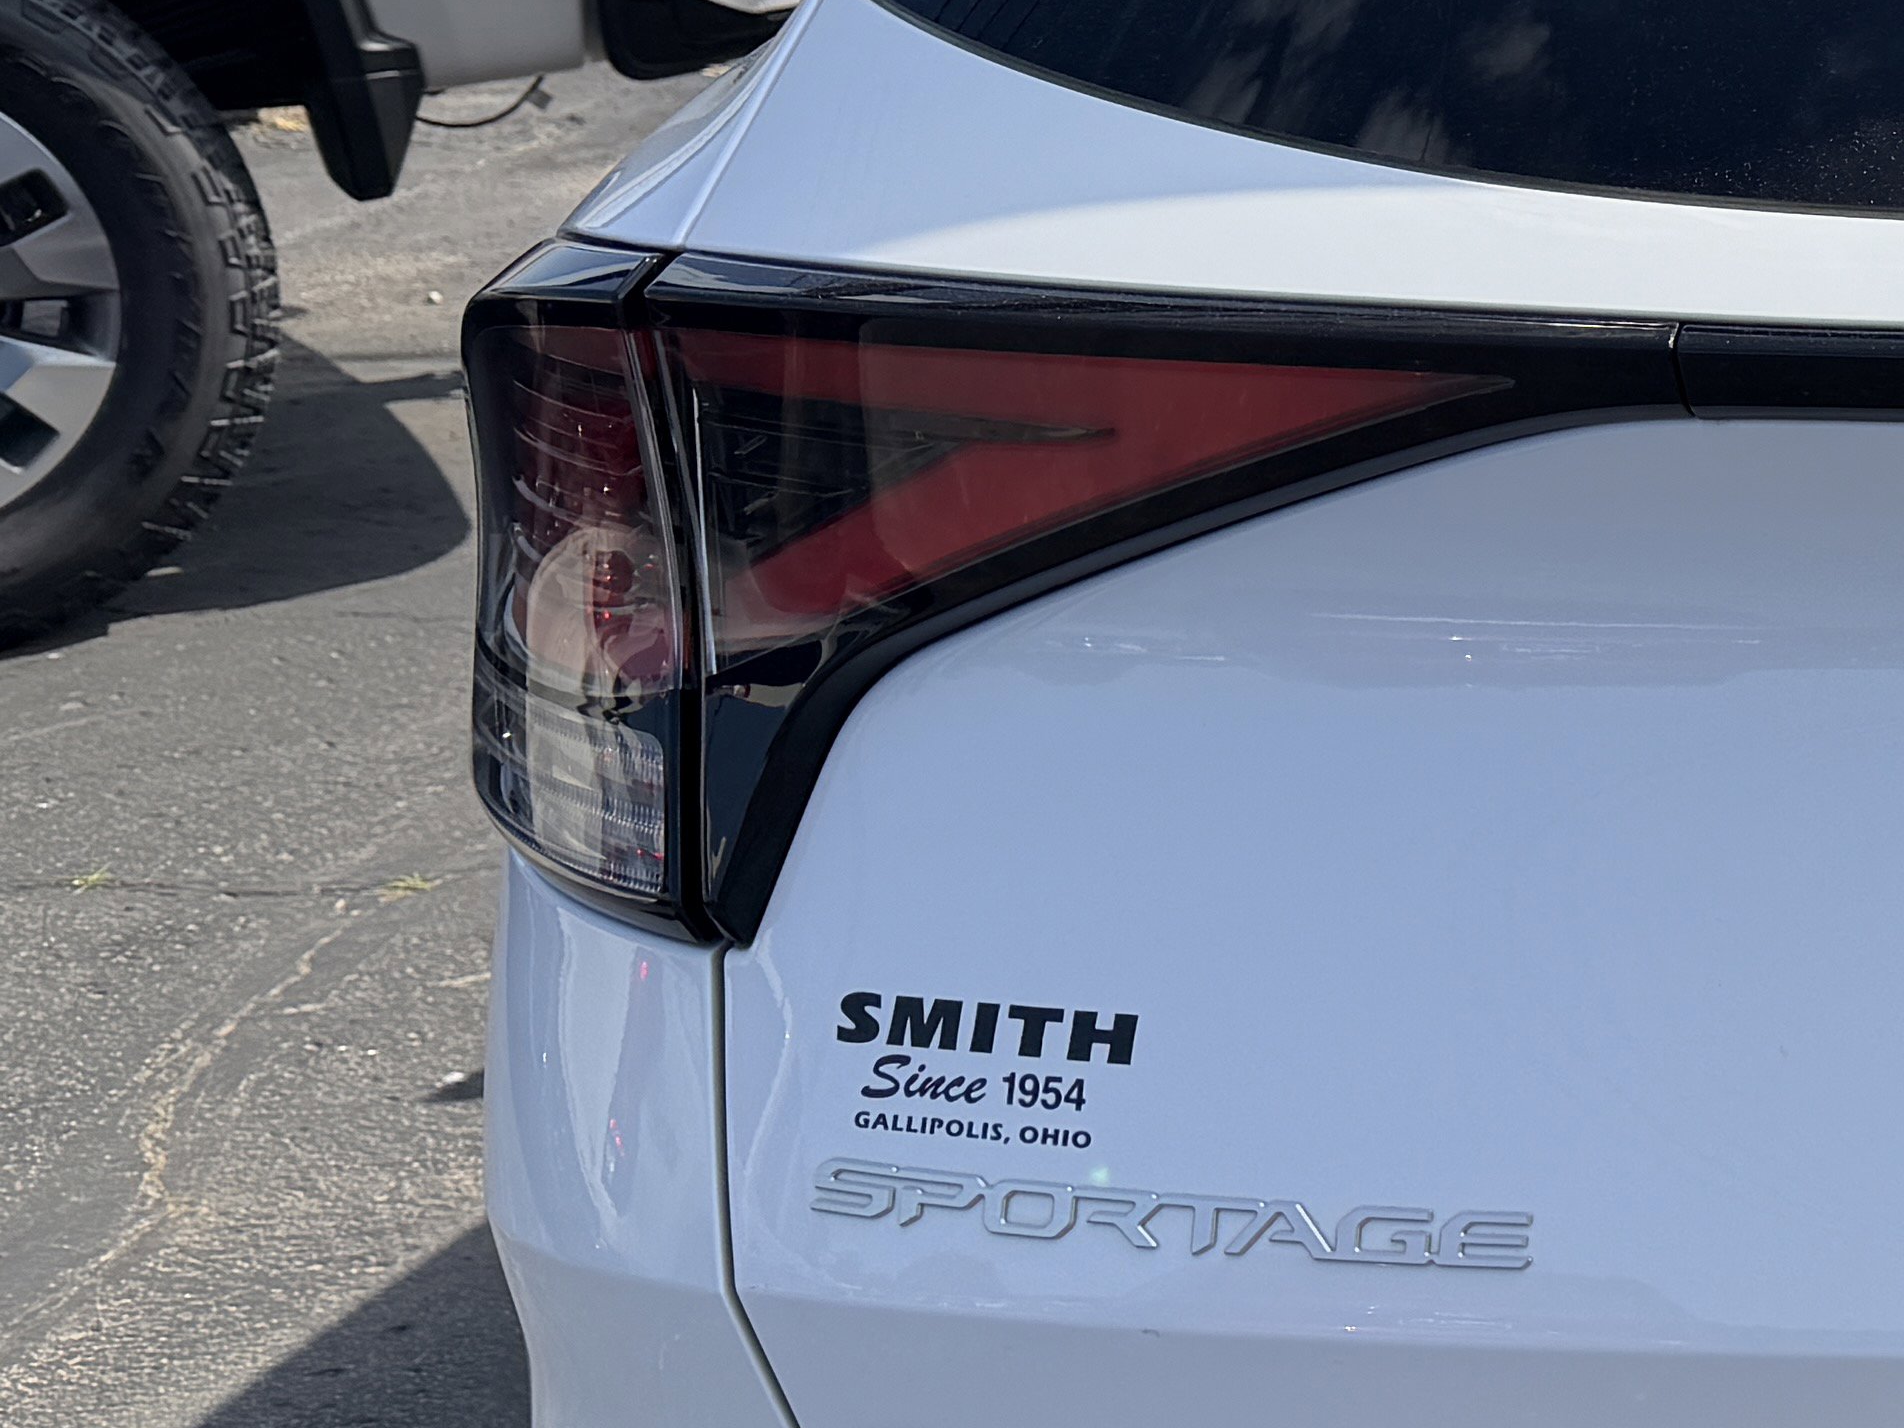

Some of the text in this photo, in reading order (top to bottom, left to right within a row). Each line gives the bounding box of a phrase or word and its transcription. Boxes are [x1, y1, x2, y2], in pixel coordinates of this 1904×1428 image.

[837, 991, 1139, 1065] SMITH
[861, 1054, 1086, 1112] Since 1954
[854, 1110, 1092, 1149] GALLIPOLIS, OHIO
[811, 1158, 1534, 1269] SPORTAGE
